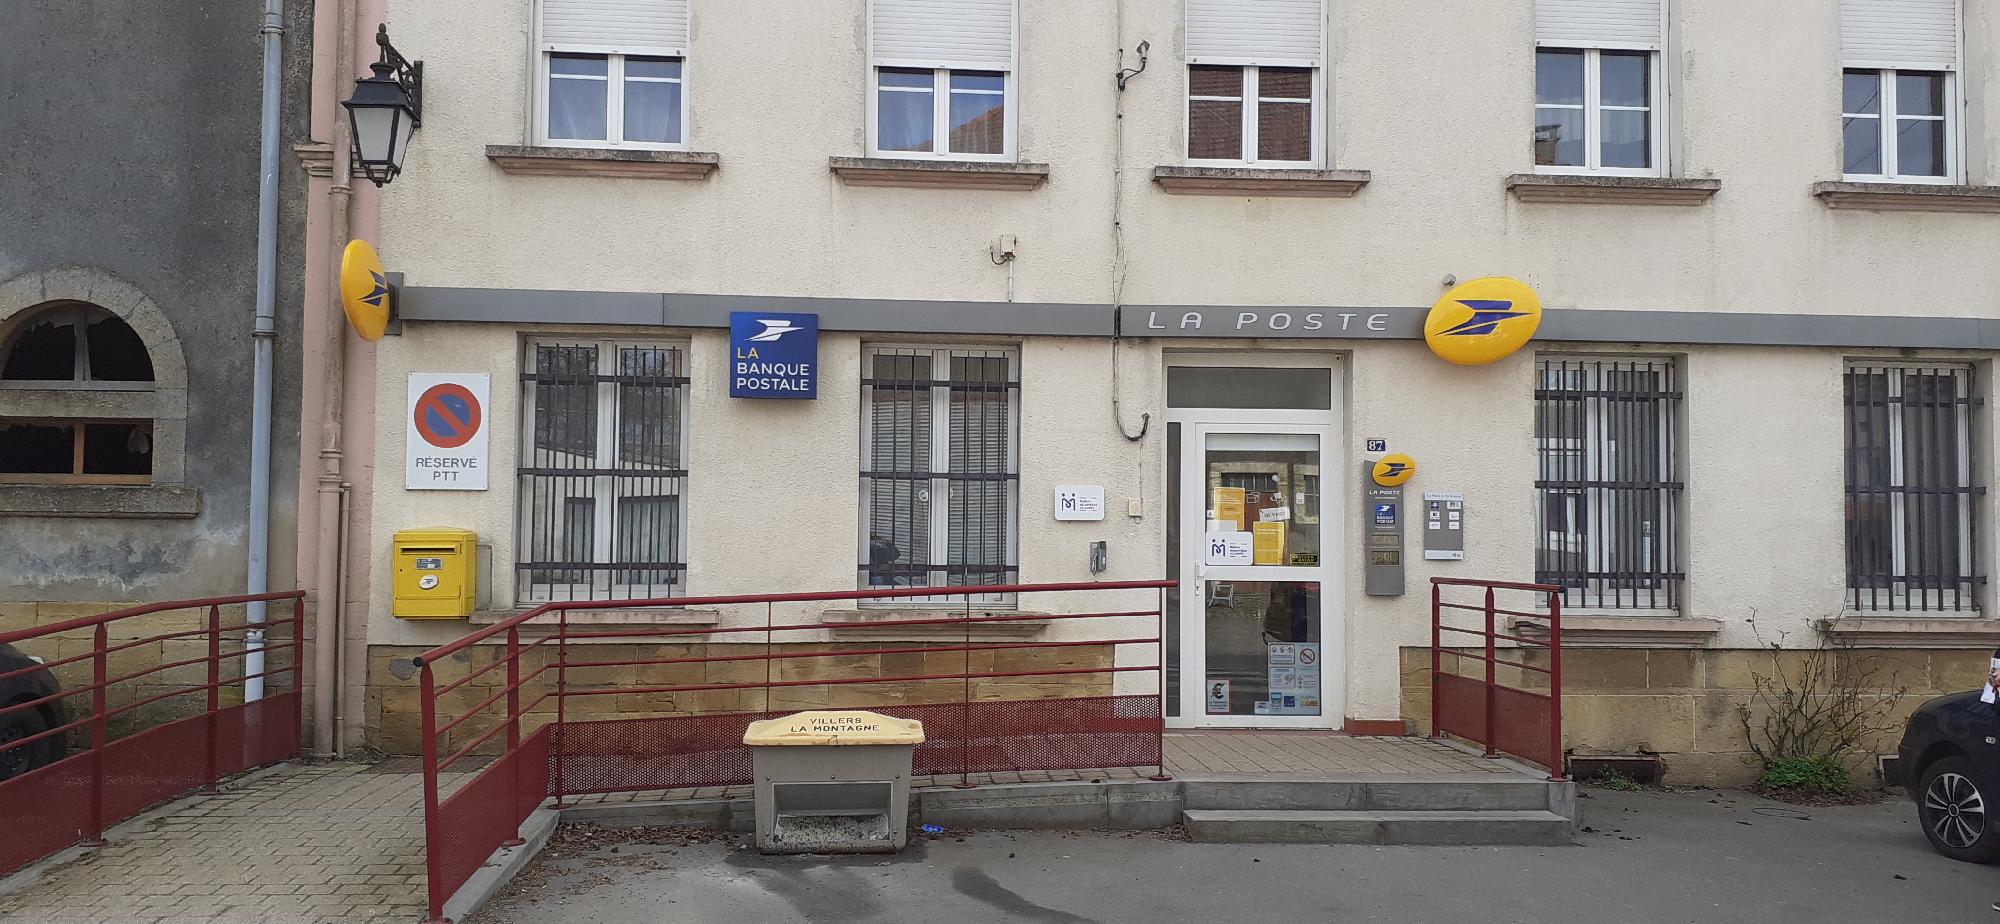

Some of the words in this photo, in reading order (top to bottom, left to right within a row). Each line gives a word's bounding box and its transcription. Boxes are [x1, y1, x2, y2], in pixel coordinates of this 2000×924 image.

[1148, 311, 1203, 330] LA
[1235, 312, 1390, 331] POSTE
[736, 346, 760, 360] LA
[736, 362, 810, 377] BANQUE
[736, 377, 810, 391] POSTALE
[1368, 440, 1384, 451] 87
[415, 455, 478, 469] RÉSERVÉ
[432, 470, 460, 481] PTT
